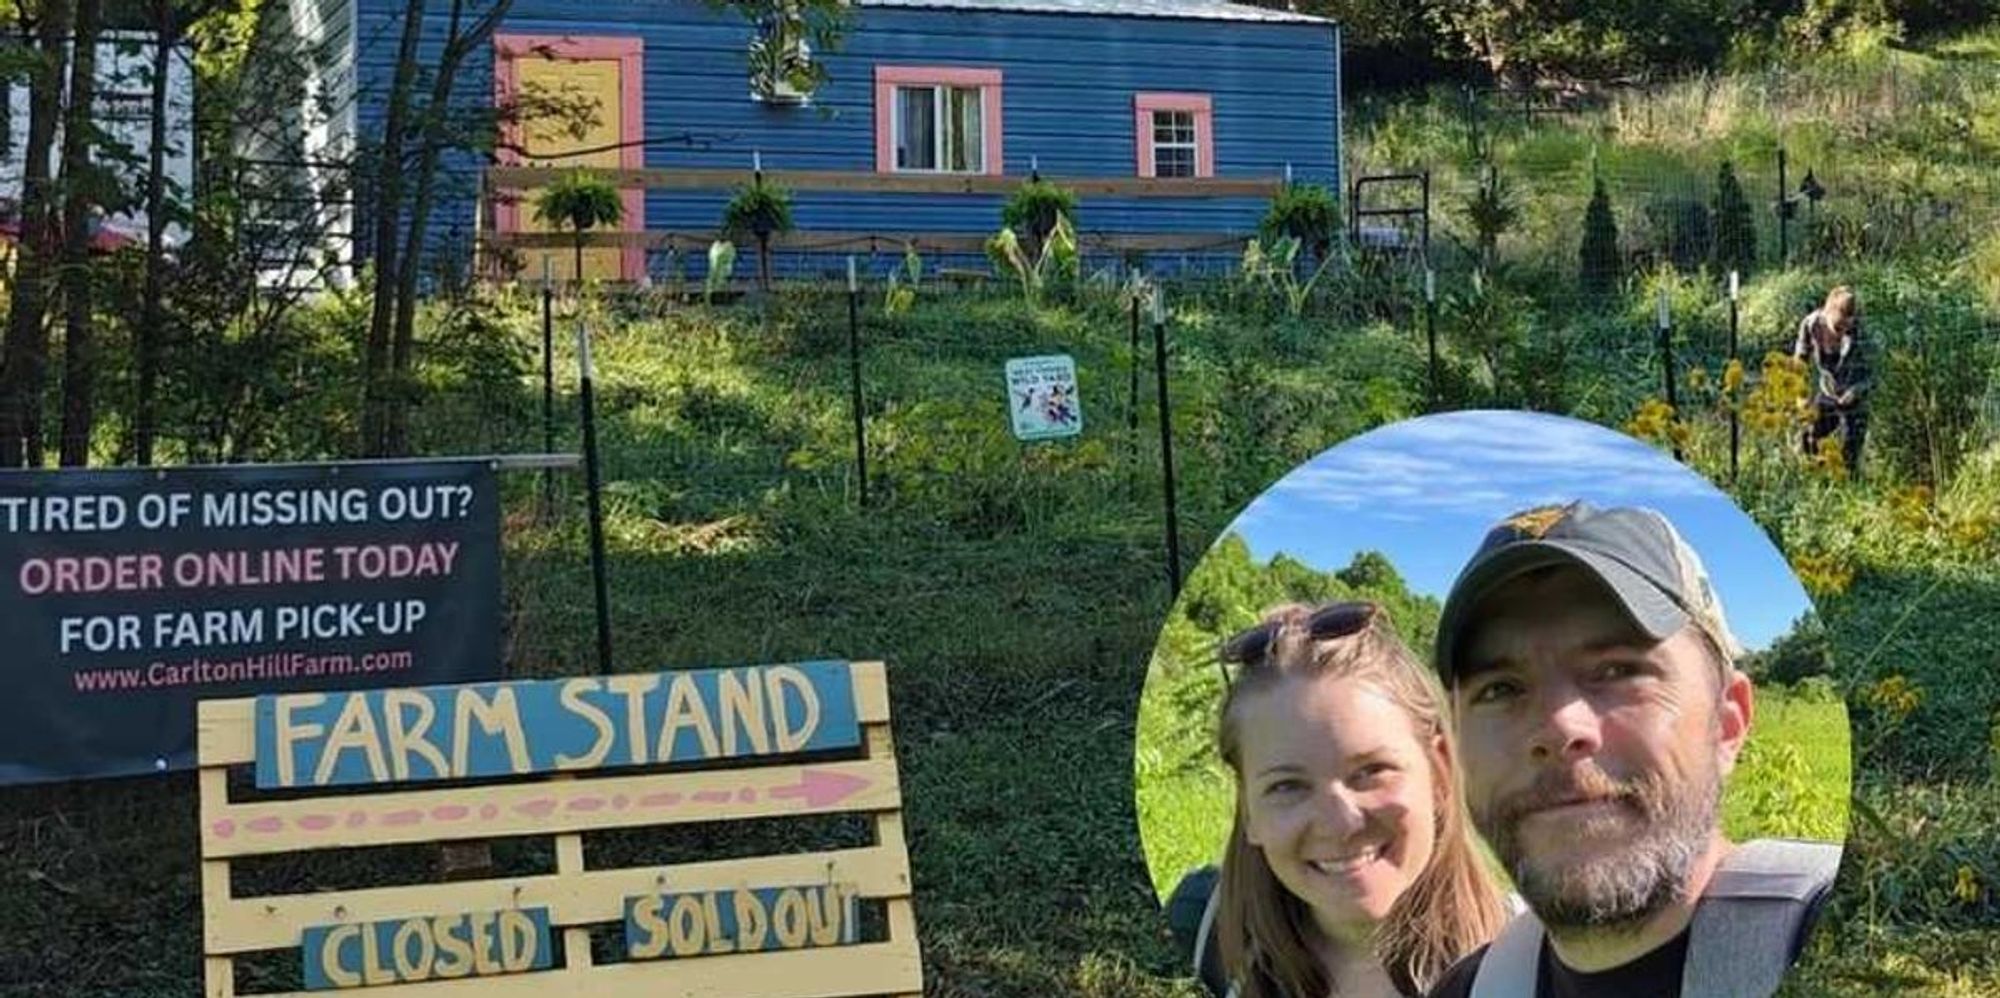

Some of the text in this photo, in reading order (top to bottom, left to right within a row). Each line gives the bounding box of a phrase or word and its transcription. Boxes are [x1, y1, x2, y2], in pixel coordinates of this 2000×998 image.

[0, 485, 474, 532] TIRED OF MISSING OUT?
[20, 541, 460, 594] ORDER ONLINE TODAY
[60, 599, 427, 653] FOR FARM PICK-UP
[75, 649, 412, 690] www.CarltonHillFarm.com
[275, 666, 821, 785] FARM STAND
[322, 911, 537, 987] CLOSED
[629, 886, 768, 959] SOLD
